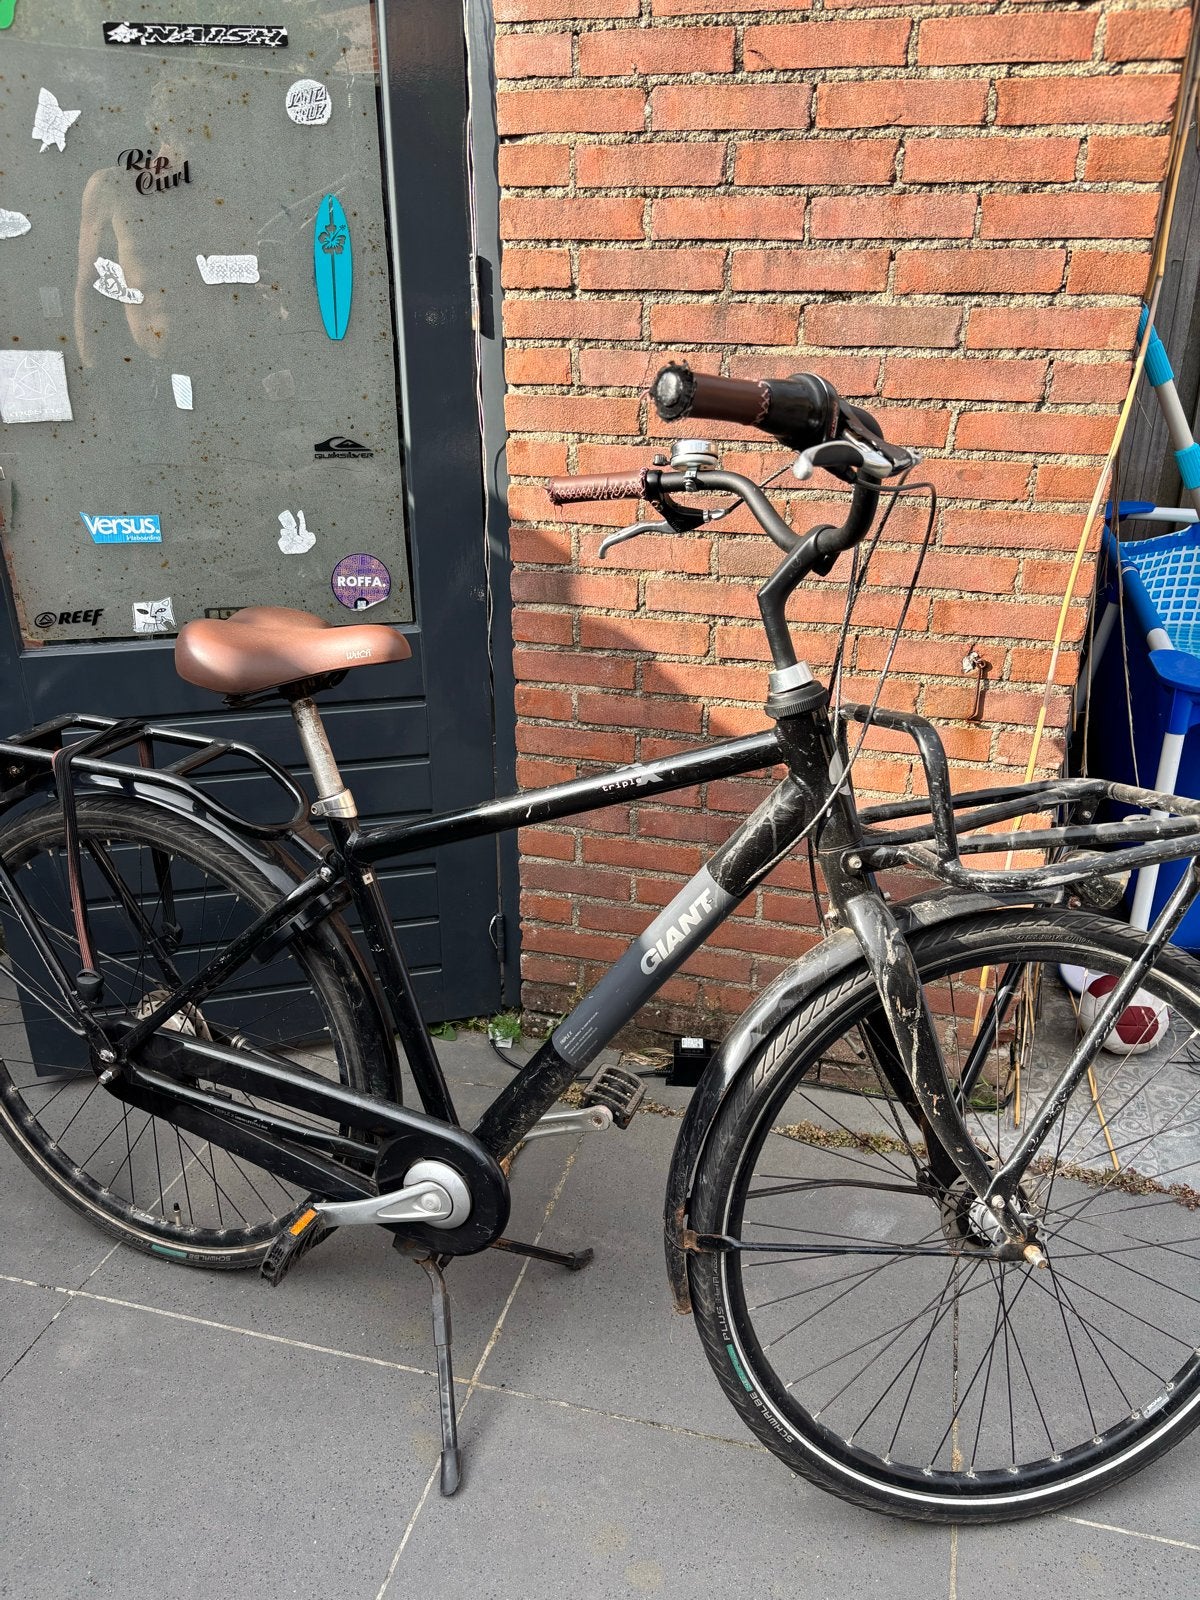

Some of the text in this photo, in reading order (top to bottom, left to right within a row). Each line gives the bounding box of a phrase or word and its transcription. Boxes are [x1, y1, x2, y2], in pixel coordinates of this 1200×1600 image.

[143, 24, 283, 46] NAISH
[117, 148, 172, 175] Rip
[135, 160, 193, 195] Curl
[337, 576, 386, 588] ROFFA.
[58, 608, 104, 626] REEF
[640, 888, 714, 975] GIANT
[716, 1306, 731, 1341] PLUS
[750, 1391, 795, 1444] SCHWALBE
